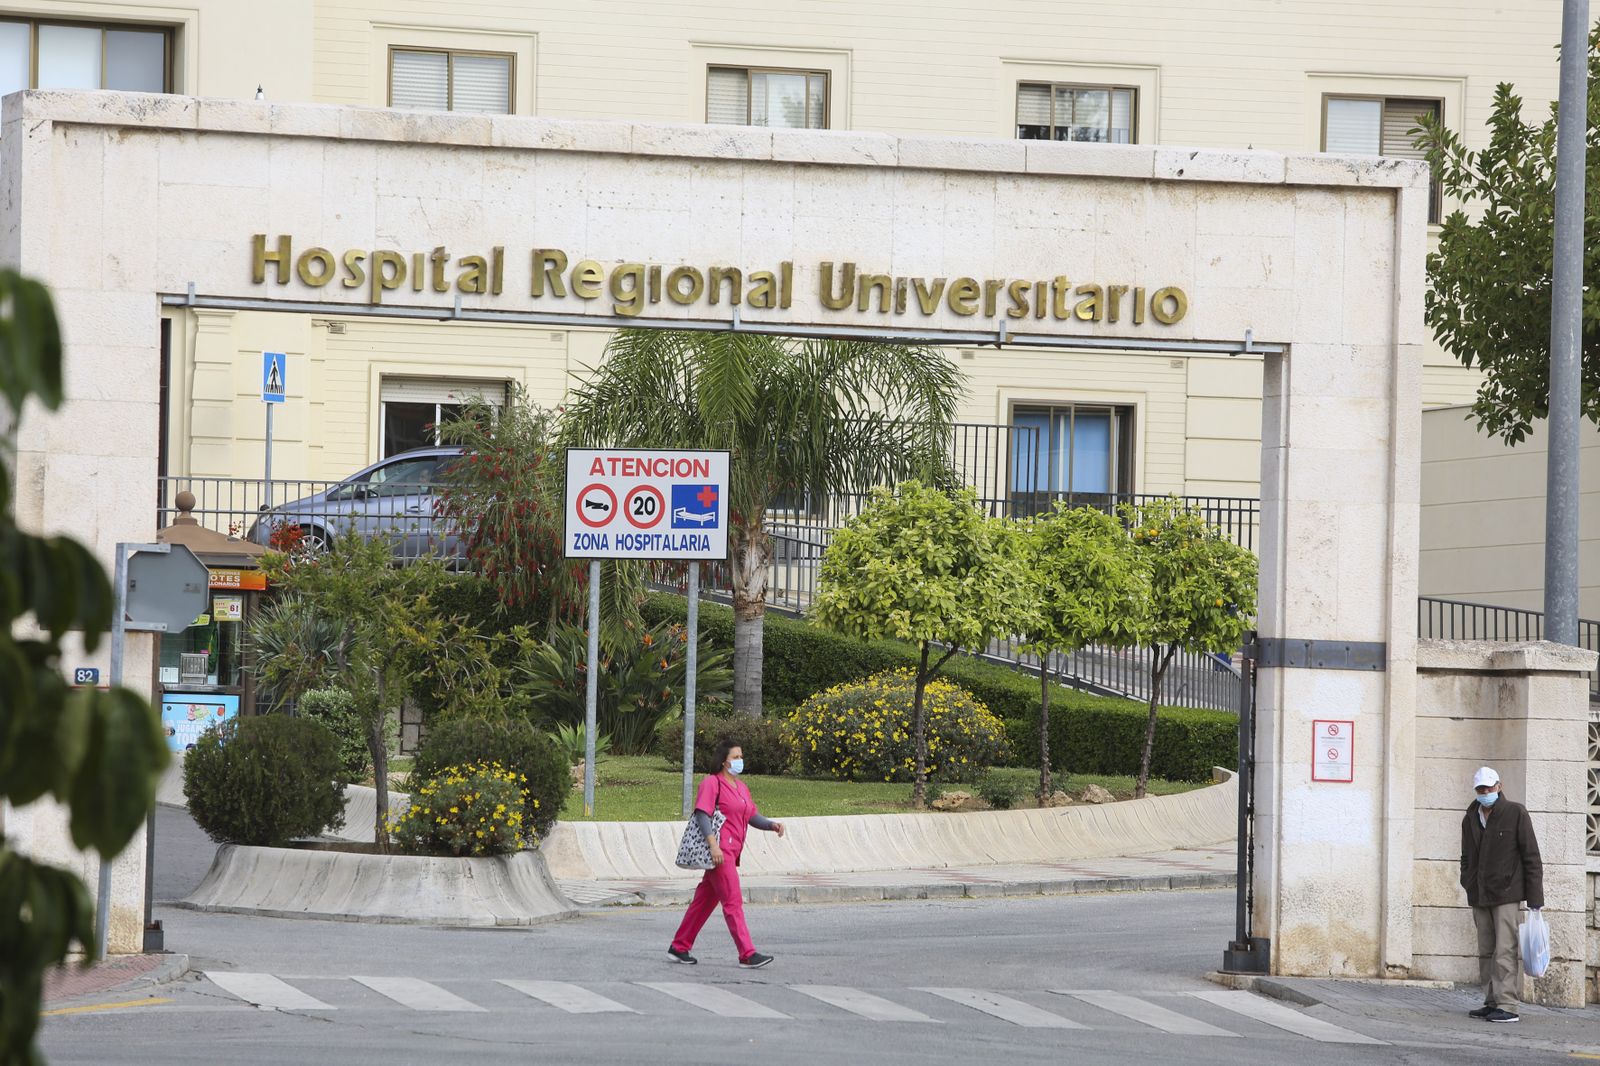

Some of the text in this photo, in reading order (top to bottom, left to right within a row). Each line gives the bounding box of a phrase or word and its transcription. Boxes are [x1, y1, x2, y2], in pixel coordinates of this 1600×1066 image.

[252, 234, 1188, 325] Hospital Regional Universitario
[589, 457, 709, 478] ATENCION
[634, 496, 655, 516] 20
[574, 533, 710, 552] ZONA HOSPITALARIA
[77, 669, 93, 682] 82
